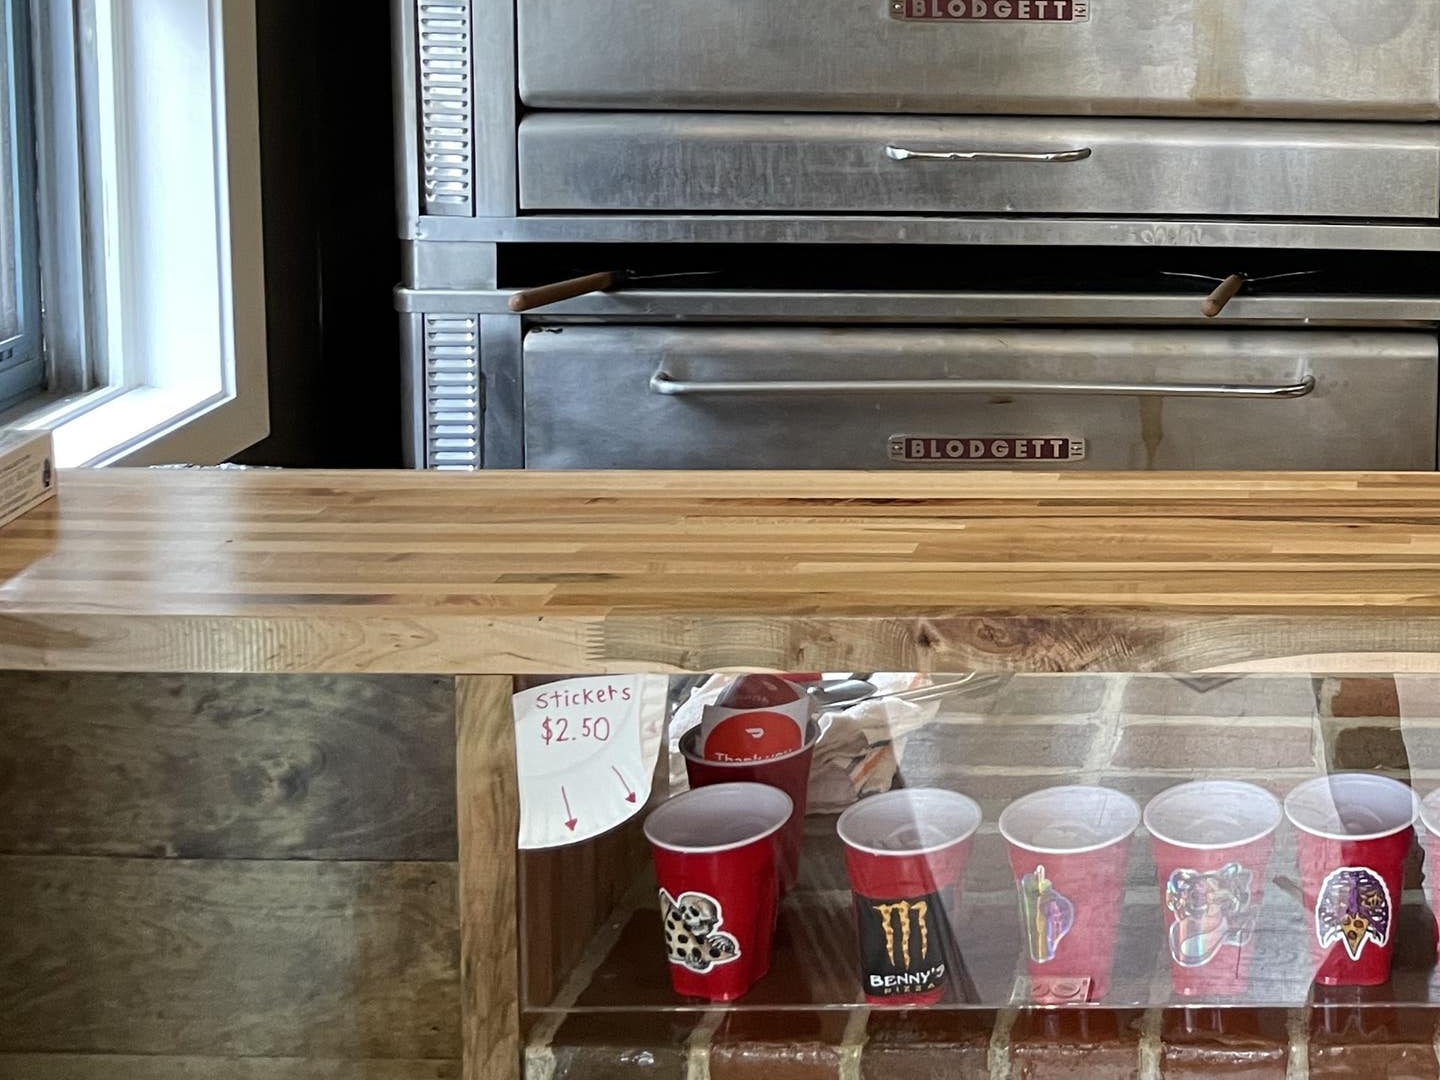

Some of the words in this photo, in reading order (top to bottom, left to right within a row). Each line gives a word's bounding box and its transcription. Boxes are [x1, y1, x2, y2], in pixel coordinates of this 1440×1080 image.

[911, 439, 1063, 458] BLODGETT
[536, 685, 632, 709] Stickers
[541, 716, 610, 745] $2.50
